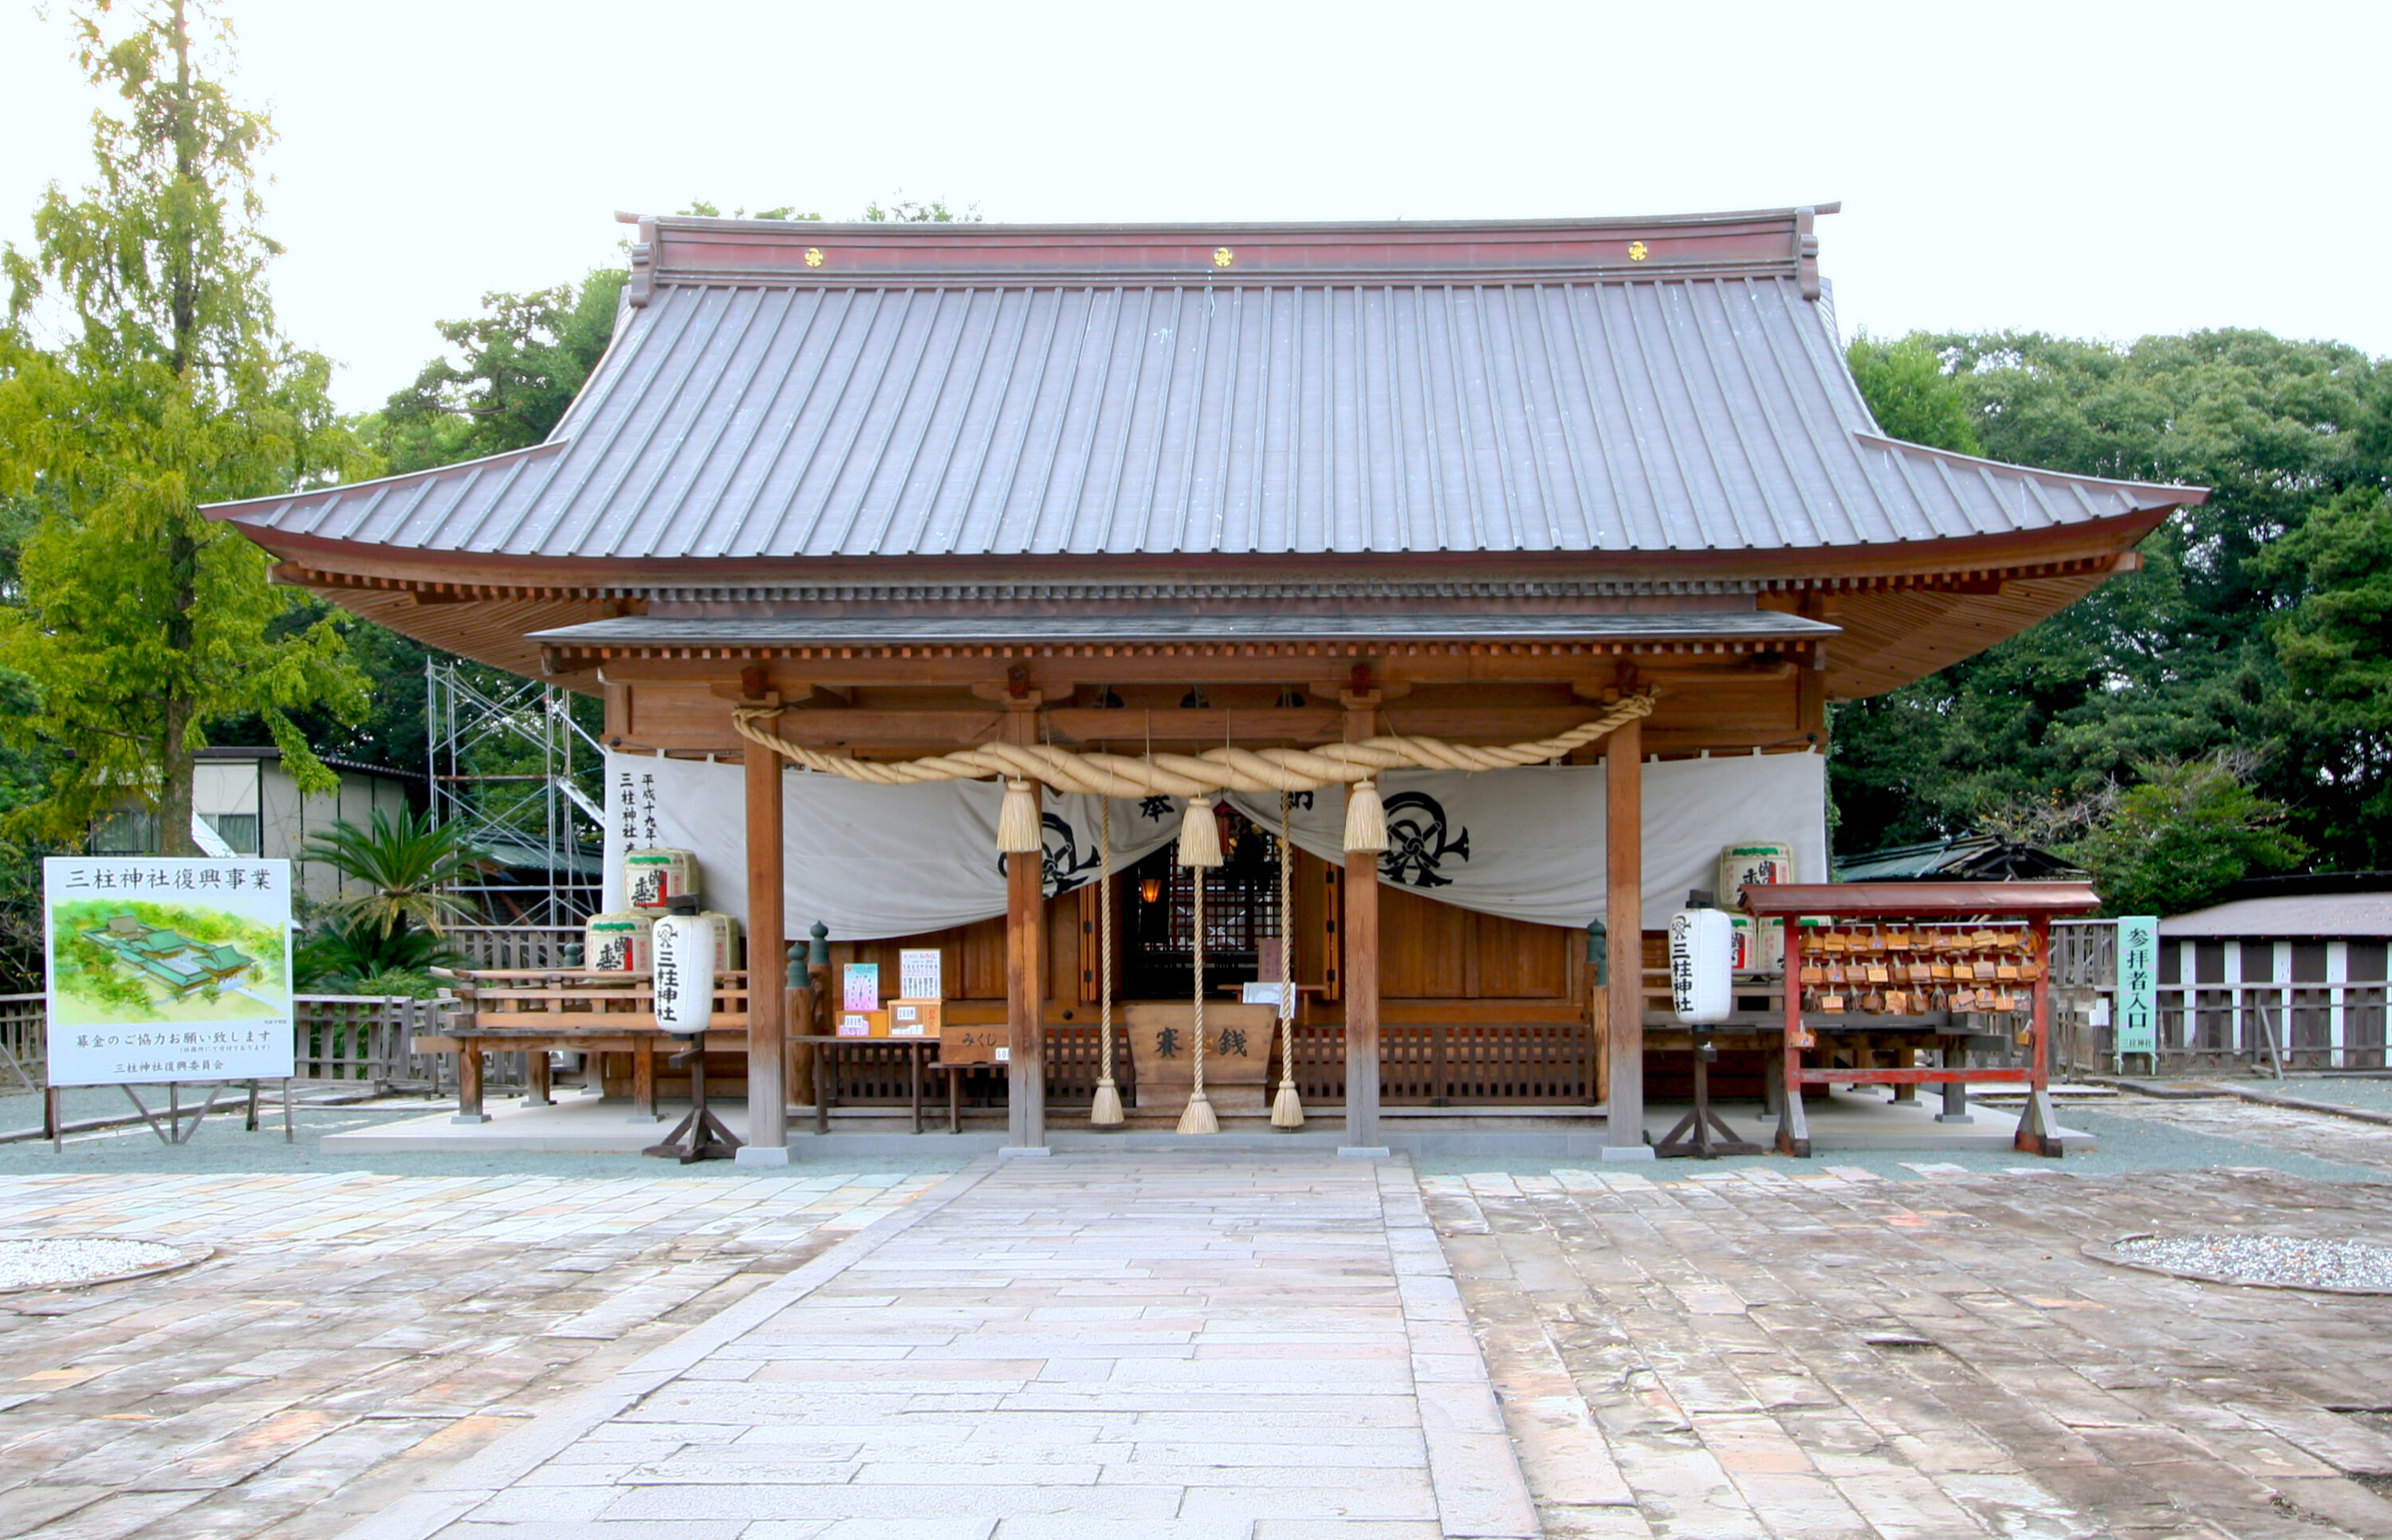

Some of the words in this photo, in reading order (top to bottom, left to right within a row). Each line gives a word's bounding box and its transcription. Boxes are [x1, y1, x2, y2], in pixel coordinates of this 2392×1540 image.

[65, 867, 273, 890] 三柱神社復興事業
[655, 950, 679, 1023] 三柱神社
[1671, 942, 1694, 1015] 三柱神社
[2126, 927, 2150, 1029] 参拝者入口
[76, 1030, 271, 1048] 募金のご協力お願い致します
[1154, 1026, 1184, 1058] 賽
[2121, 1038, 2152, 1048] 三柱神社
[997, 1049, 1009, 1059] 50
[113, 1059, 224, 1073] 三柱神社復興委員会
